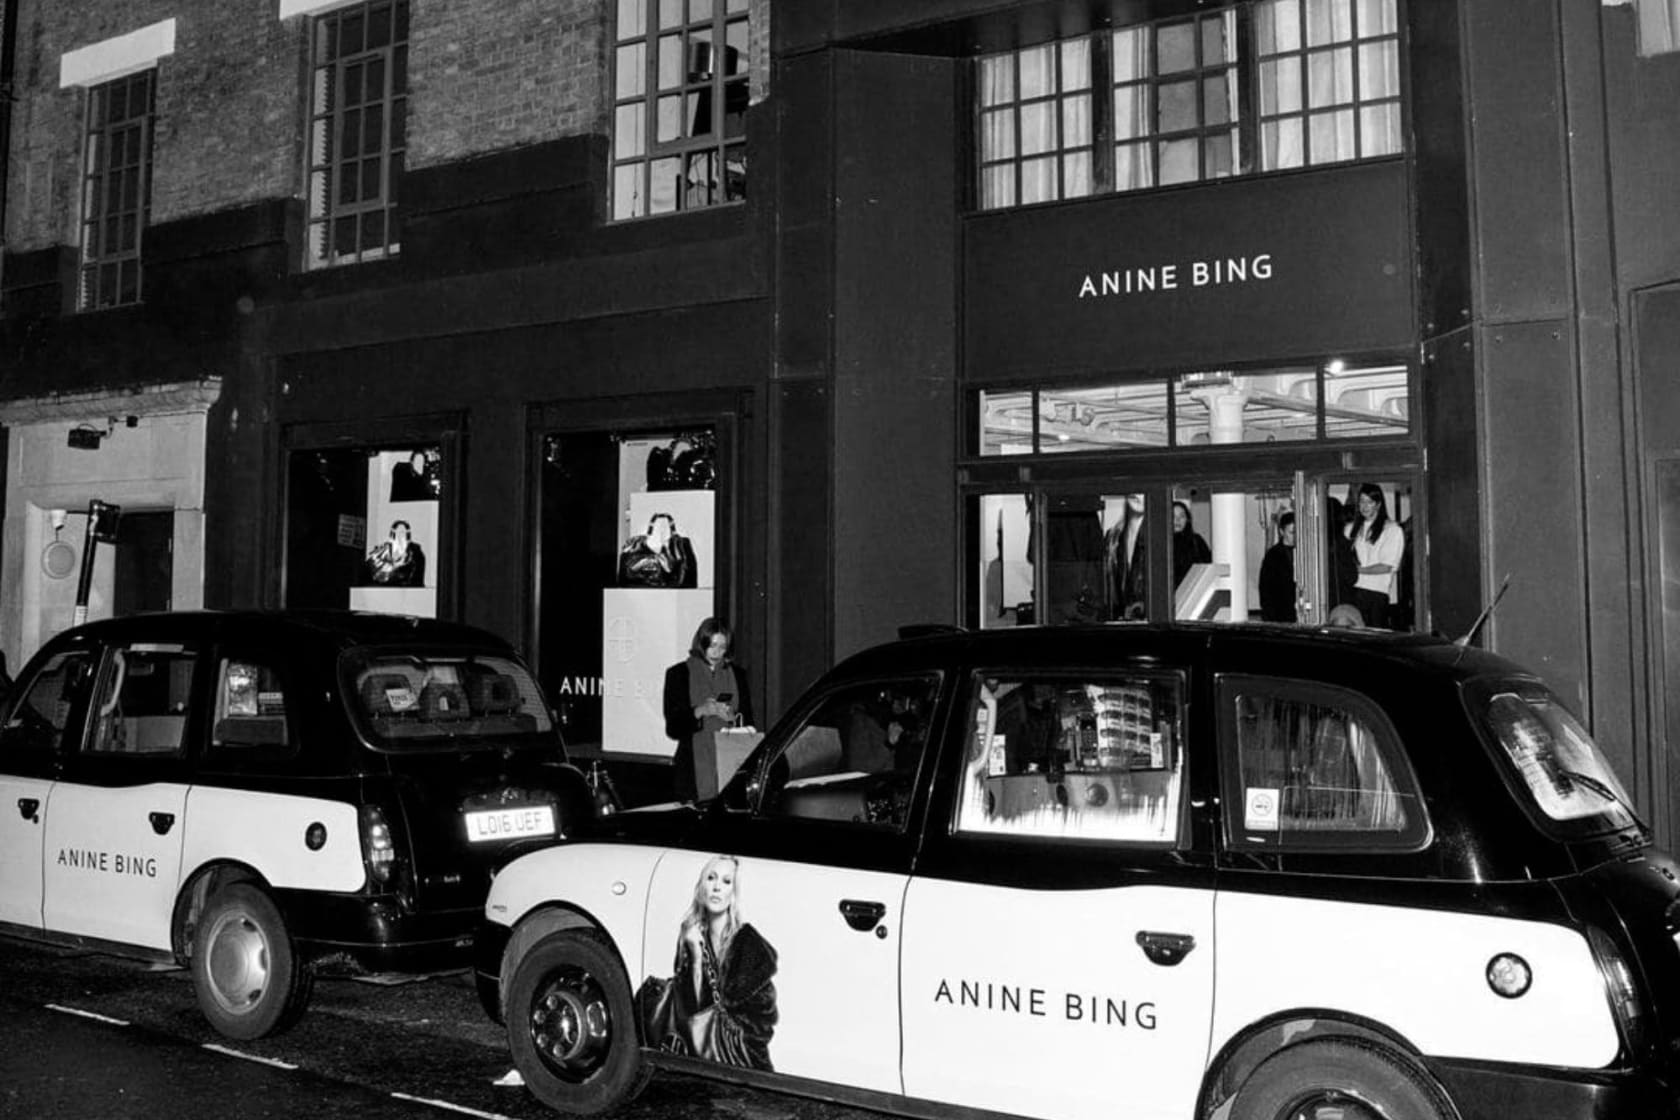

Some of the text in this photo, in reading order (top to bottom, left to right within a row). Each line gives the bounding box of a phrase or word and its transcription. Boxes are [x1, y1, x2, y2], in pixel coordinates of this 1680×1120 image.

[1078, 254, 1272, 298] ANINE BING
[57, 848, 156, 877] ANINE BING
[934, 978, 1157, 1029] ANINE BING
